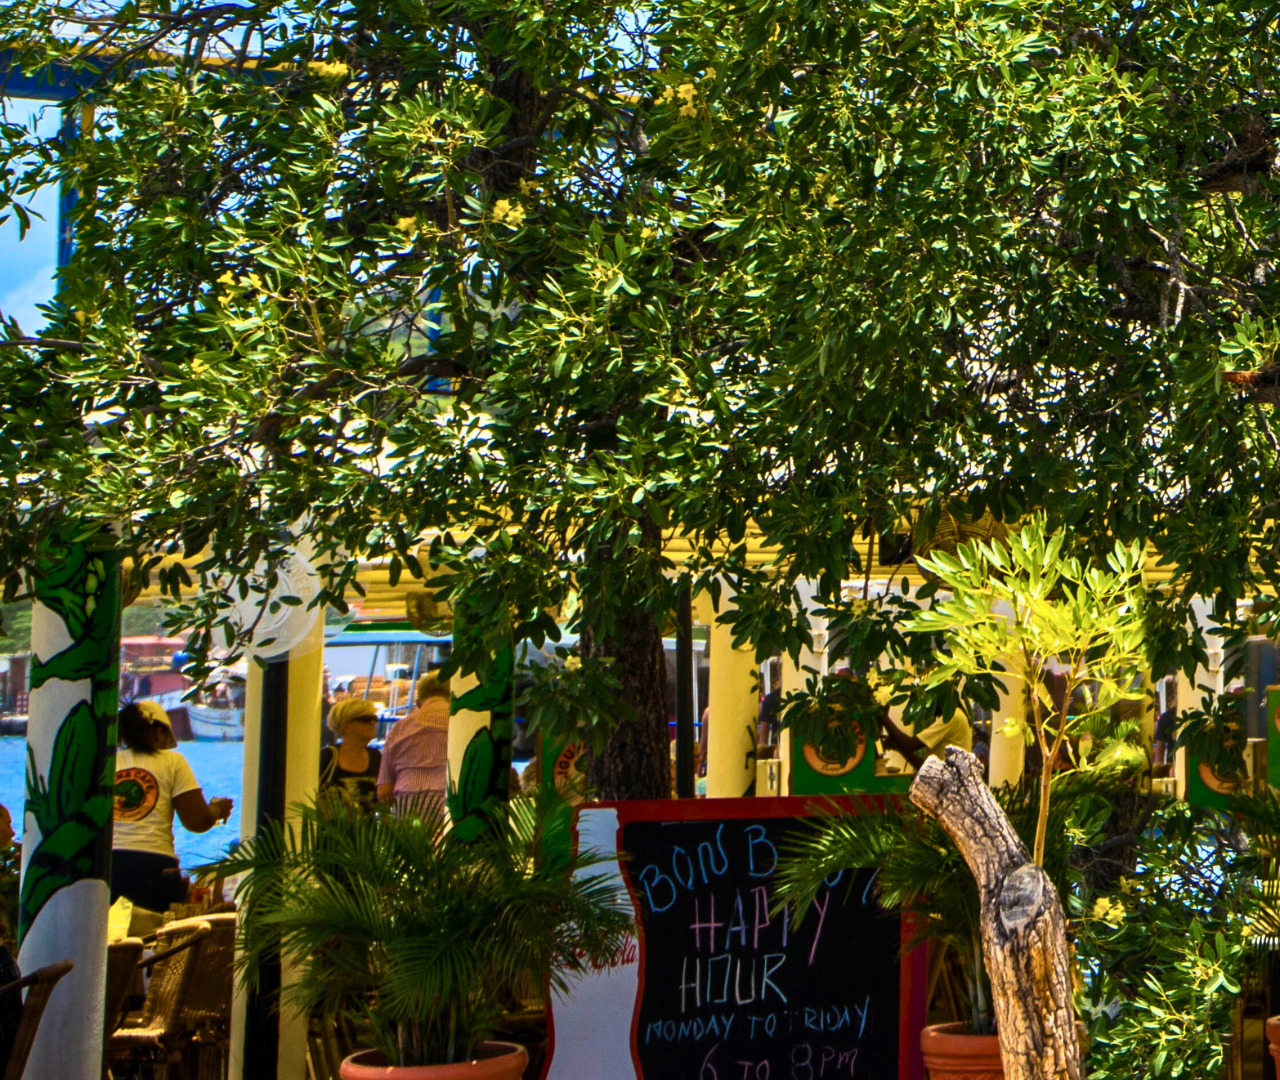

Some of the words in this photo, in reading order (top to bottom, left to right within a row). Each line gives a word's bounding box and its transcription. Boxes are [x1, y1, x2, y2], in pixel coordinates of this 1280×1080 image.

[639, 823, 728, 913] BON
[679, 953, 788, 1013] HOUR
[646, 1012, 735, 1045] MONDAY
[747, 1013, 777, 1041] TO
[700, 1043, 720, 1080] 6
[737, 1059, 770, 1080] TO
